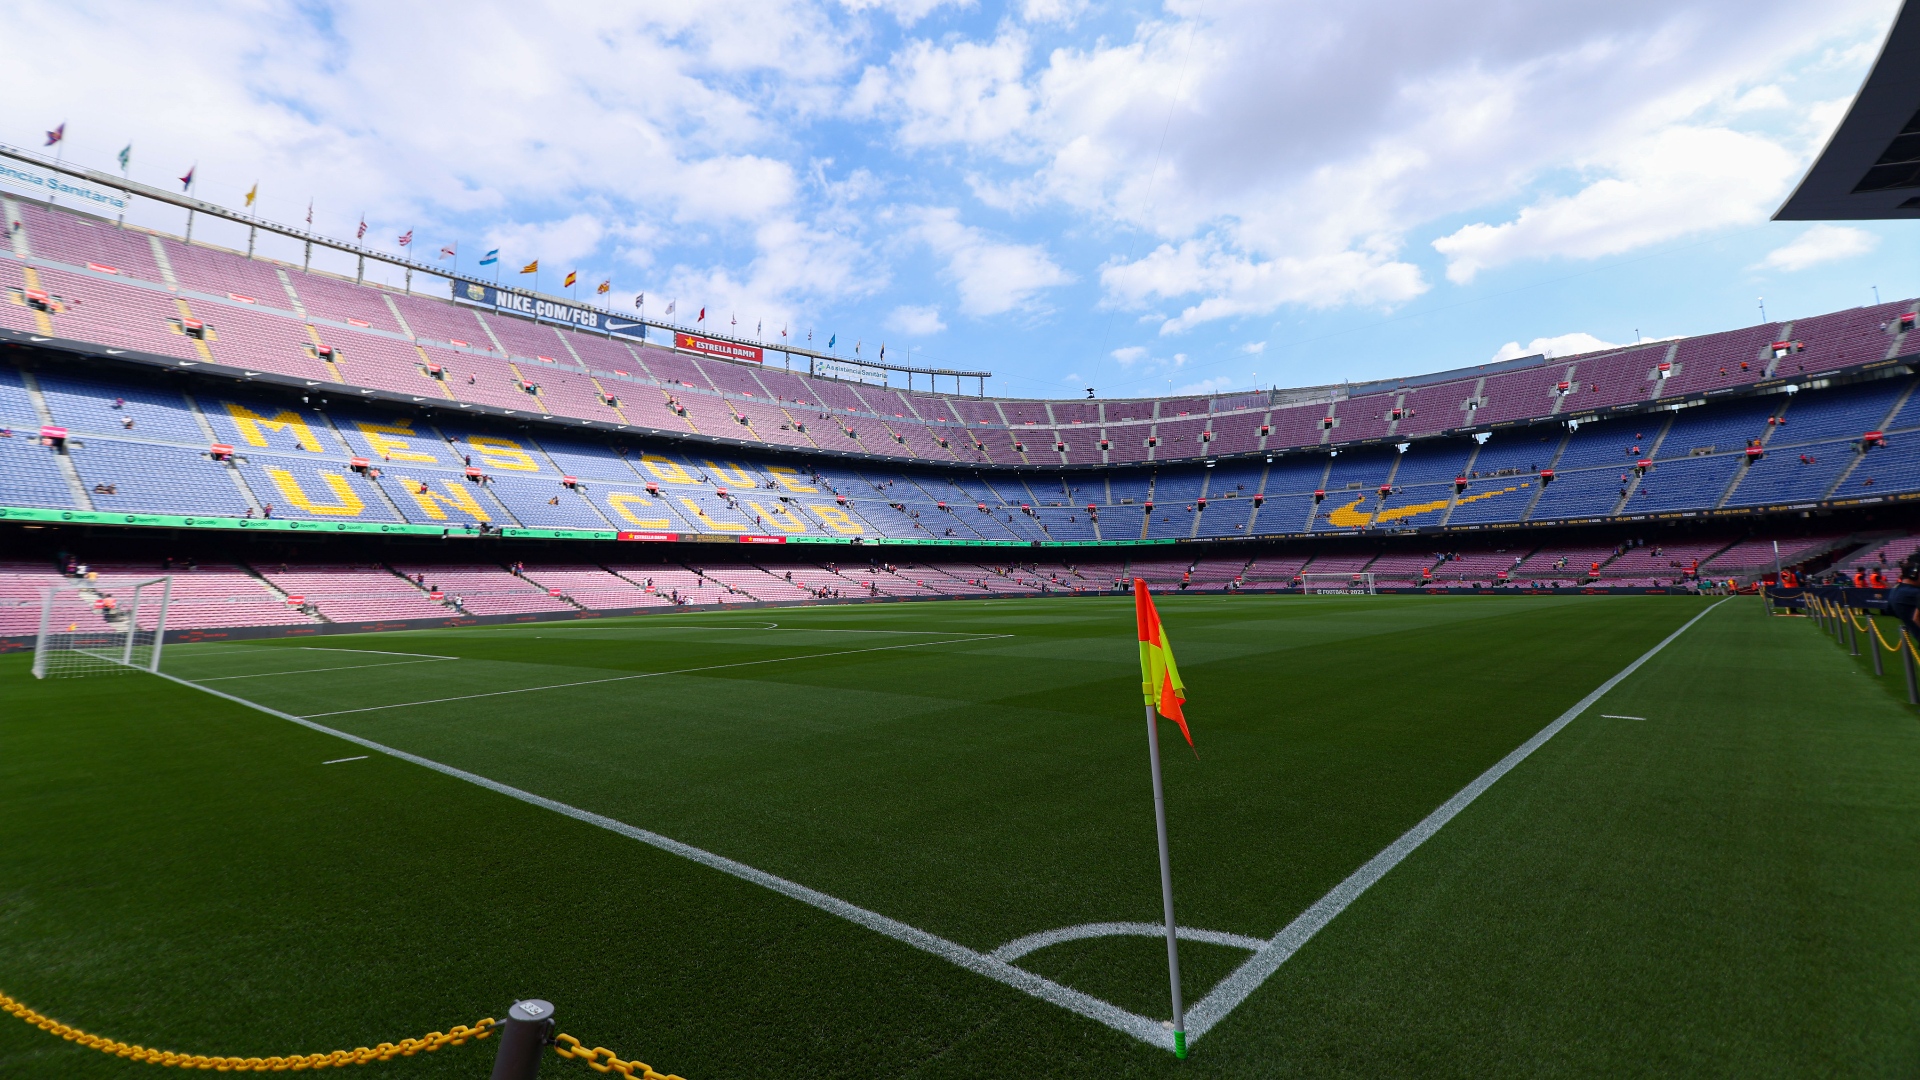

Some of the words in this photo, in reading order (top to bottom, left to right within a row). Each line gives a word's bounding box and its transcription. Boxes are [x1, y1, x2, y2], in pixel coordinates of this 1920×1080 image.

[496, 291, 598, 328] NIKE.COM/FCB
[696, 341, 732, 354] ESTRELLA
[732, 347, 755, 358] DAMM
[225, 403, 540, 472] MÉS
[641, 455, 819, 494] QUE
[267, 469, 492, 522] UN
[606, 494, 864, 534] CLUB
